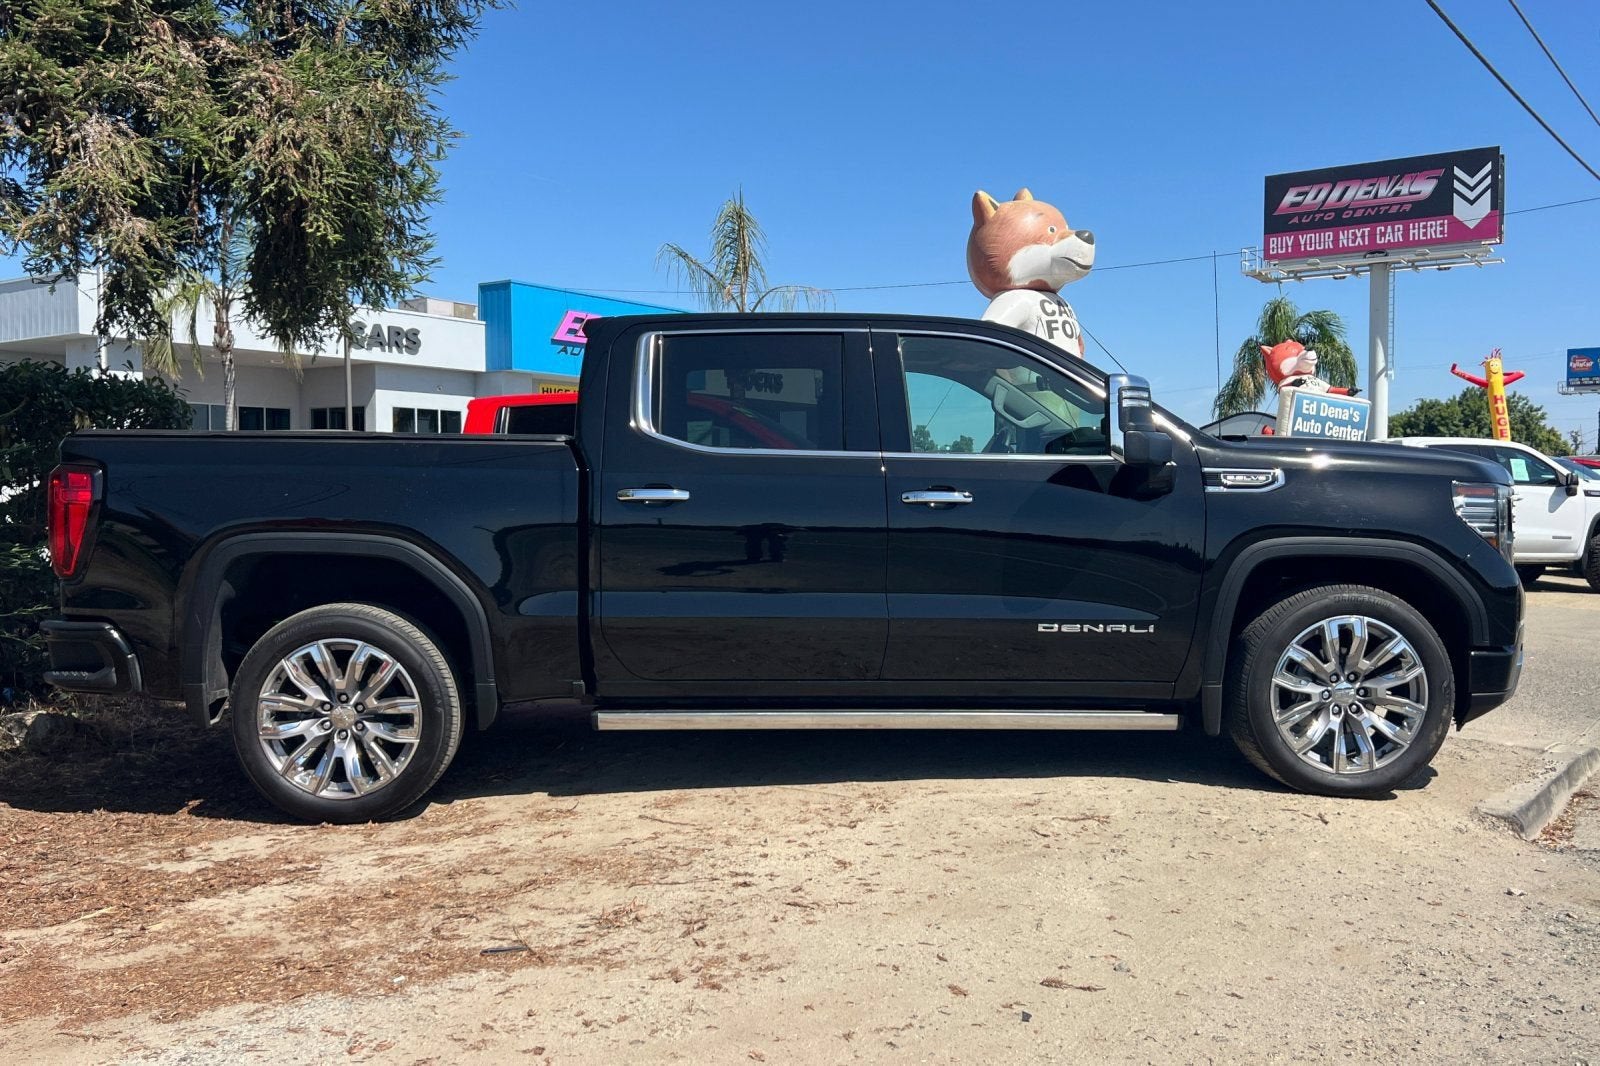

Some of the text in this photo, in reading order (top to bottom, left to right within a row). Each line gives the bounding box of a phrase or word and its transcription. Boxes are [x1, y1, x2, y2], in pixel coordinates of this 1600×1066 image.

[1272, 183, 1333, 215] ED
[1288, 204, 1412, 224] AUTO CENTER
[1269, 219, 1448, 254] BUY YOUR NEXT CAR HERE!
[1039, 299, 1074, 318] CA
[351, 321, 421, 355] CARS
[1045, 319, 1078, 340] FO
[557, 345, 583, 356] AU
[1302, 399, 1360, 423] Ed Dena's
[1493, 394, 1508, 438] HUGE
[1294, 417, 1365, 440] Auto Center
[1037, 623, 1155, 634] DENALI
